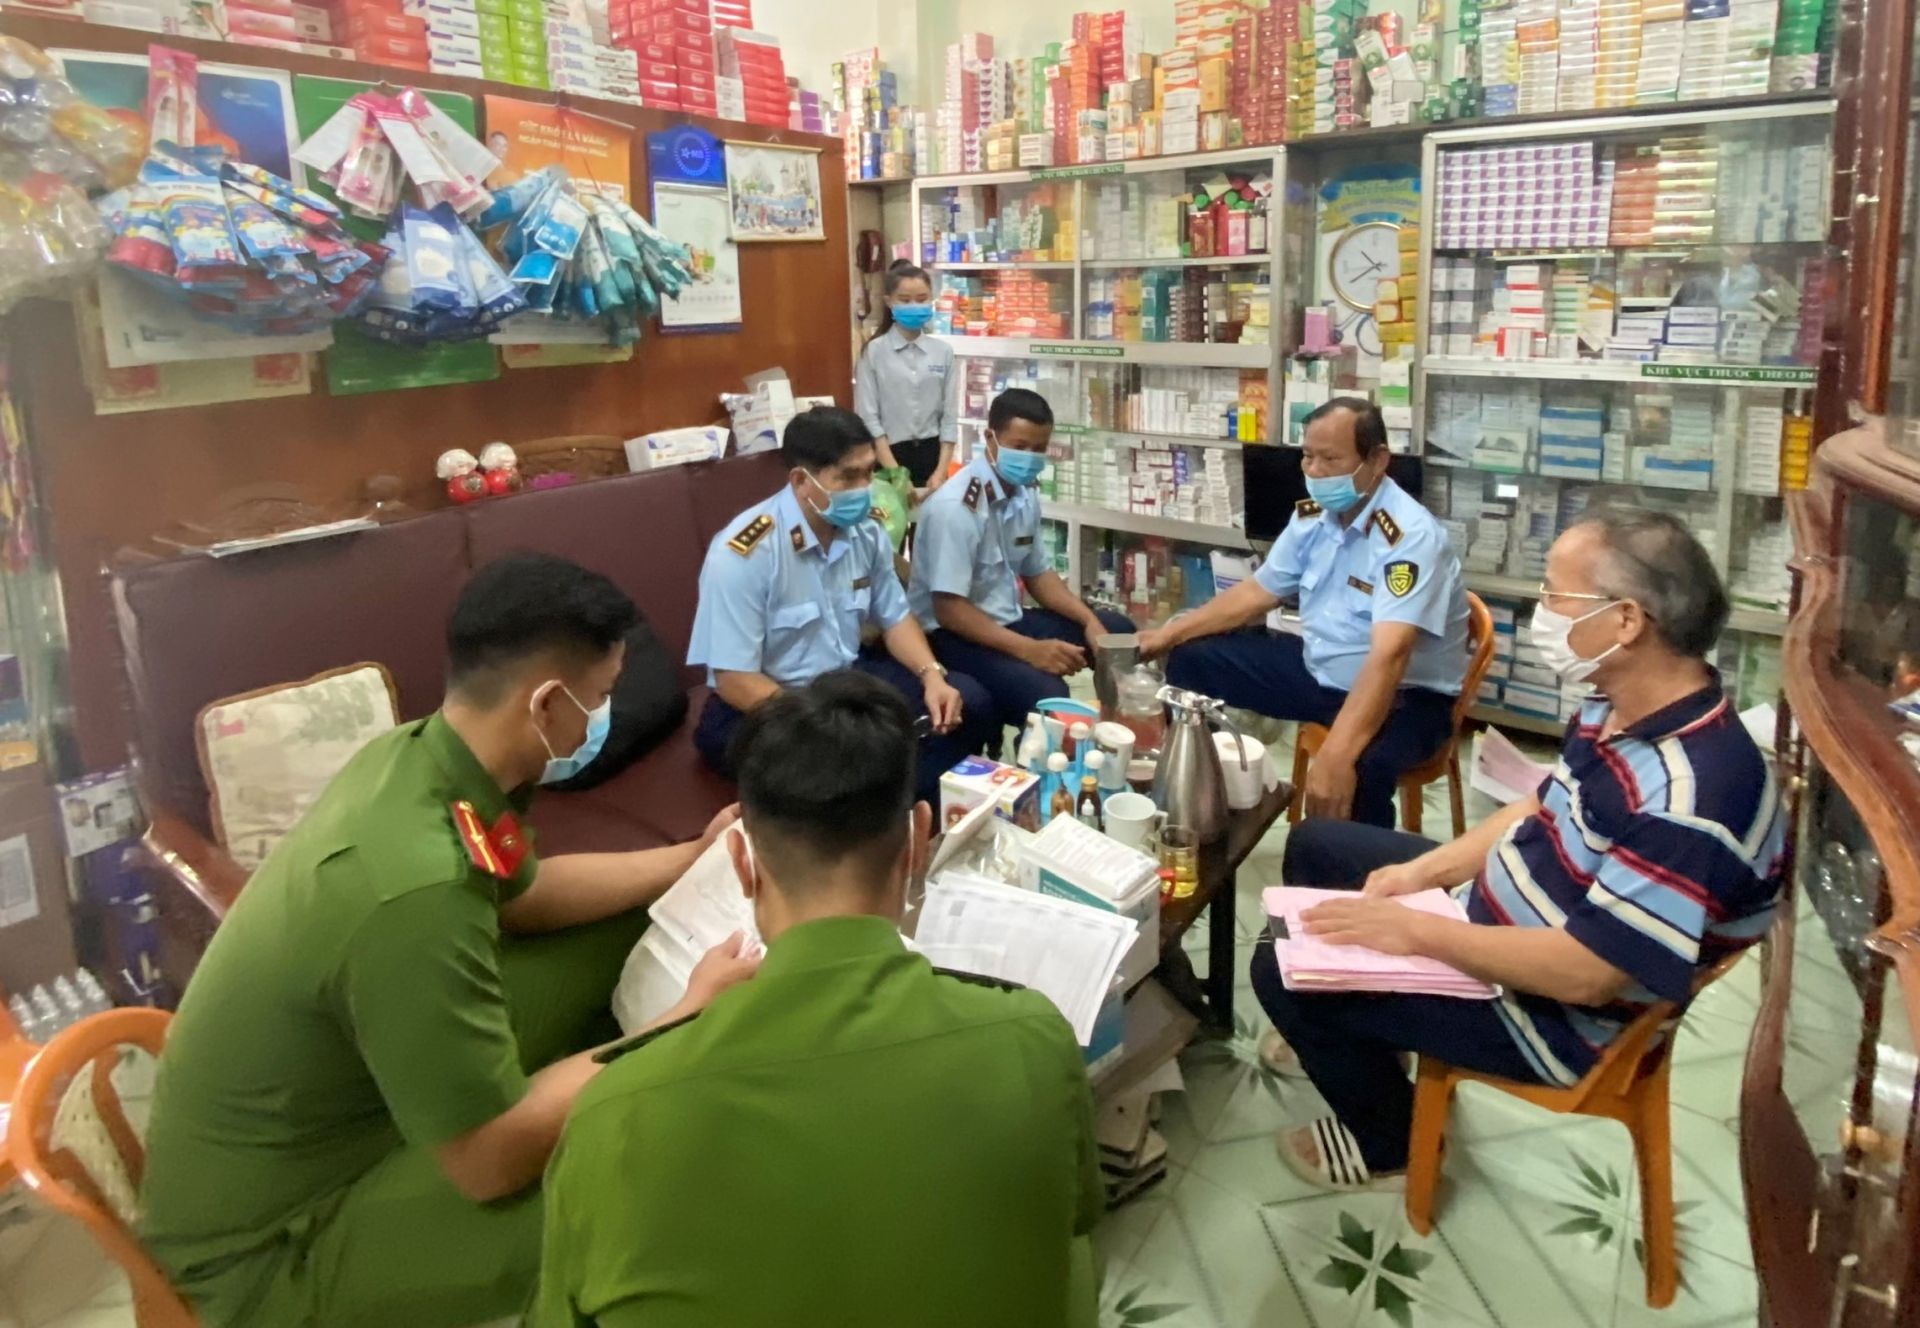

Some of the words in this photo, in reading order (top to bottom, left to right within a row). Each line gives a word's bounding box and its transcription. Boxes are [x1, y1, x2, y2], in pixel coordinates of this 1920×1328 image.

[1646, 366, 1672, 376] KHU
[1677, 367, 1704, 378] VỰC
[1759, 370, 1796, 380] THEO
